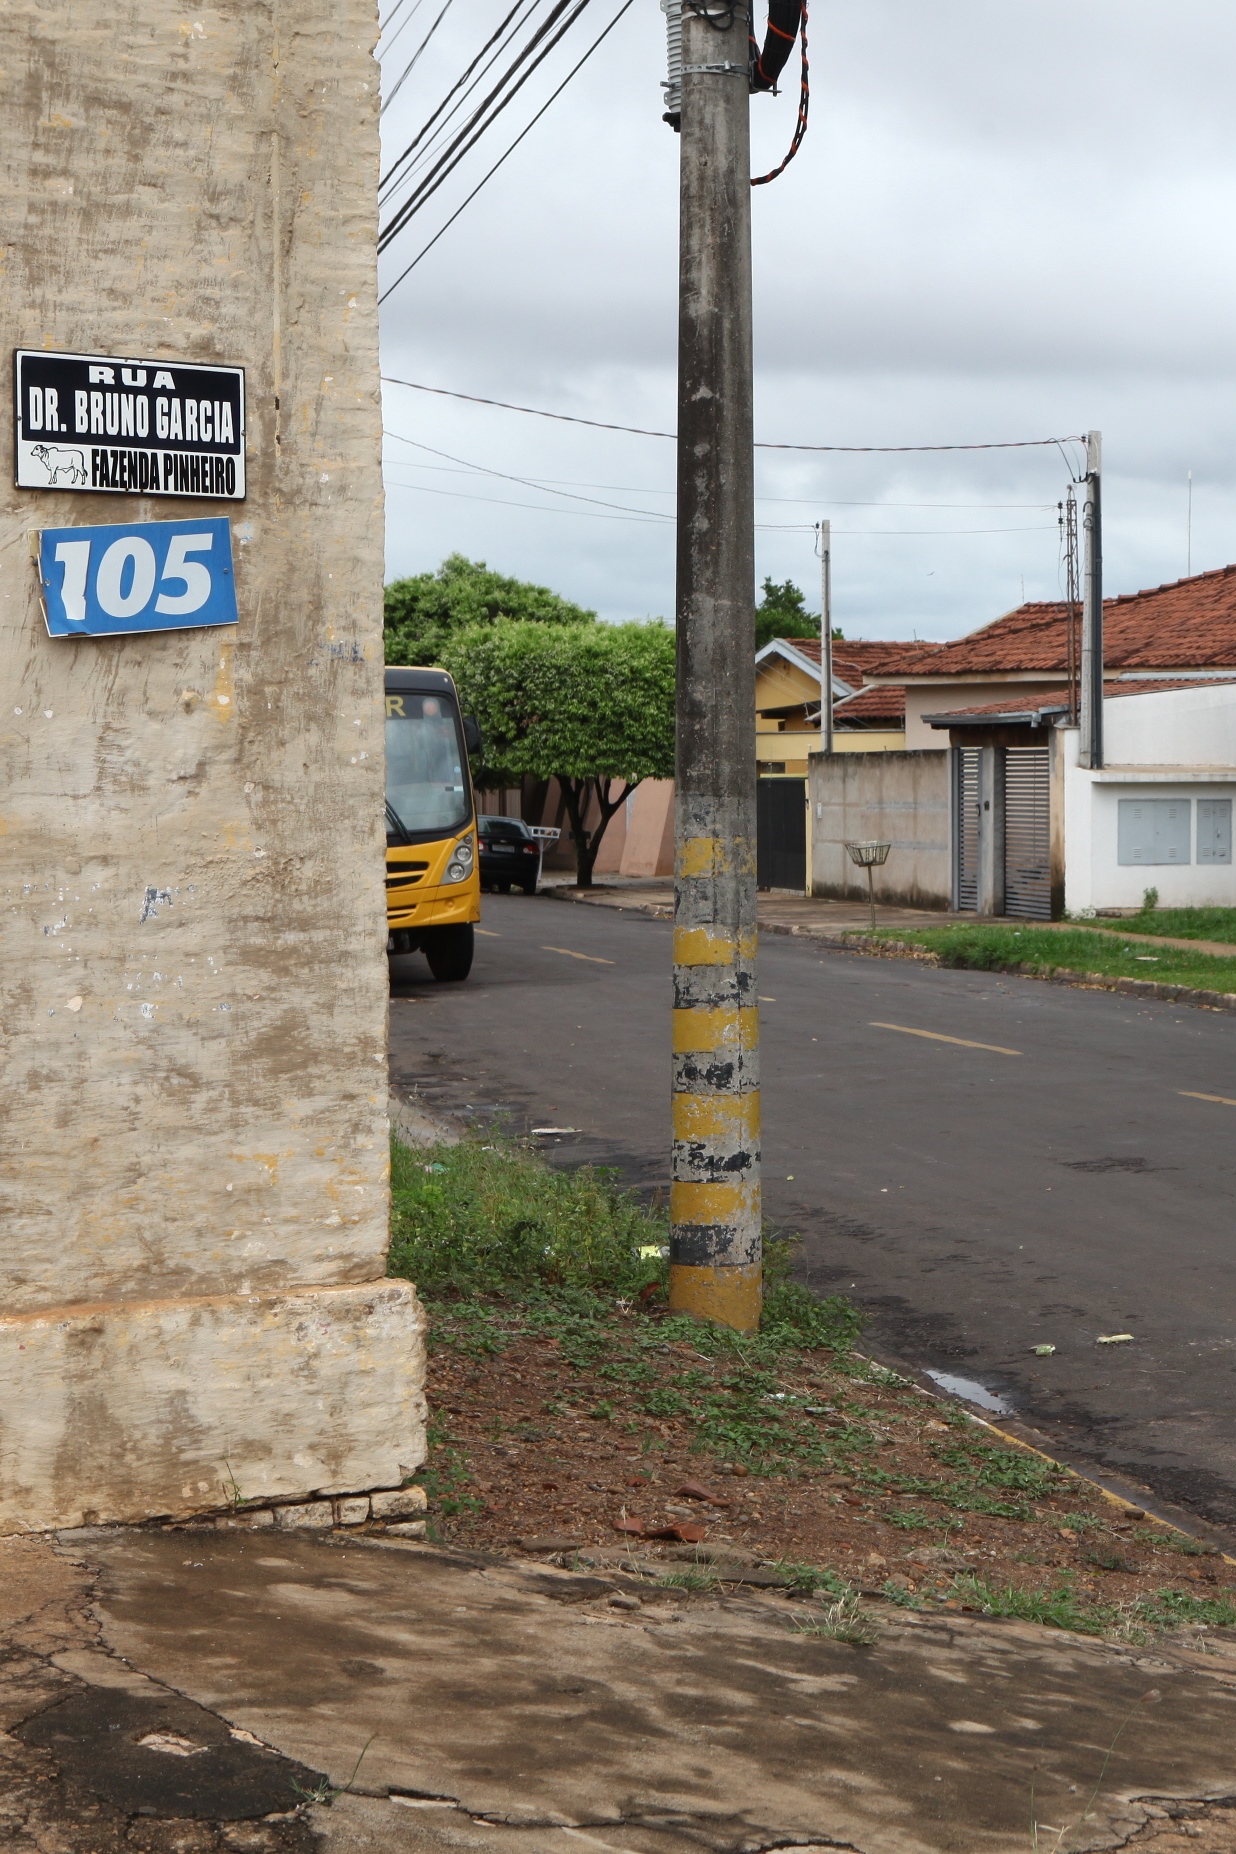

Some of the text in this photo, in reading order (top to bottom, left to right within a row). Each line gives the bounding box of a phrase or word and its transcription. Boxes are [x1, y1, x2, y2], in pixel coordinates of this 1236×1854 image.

[88, 365, 176, 390] RUA
[28, 386, 235, 444] DR. BRUNO GARCIA
[91, 448, 236, 496] FAZENDA PINHEIRO
[54, 532, 214, 621] 105
